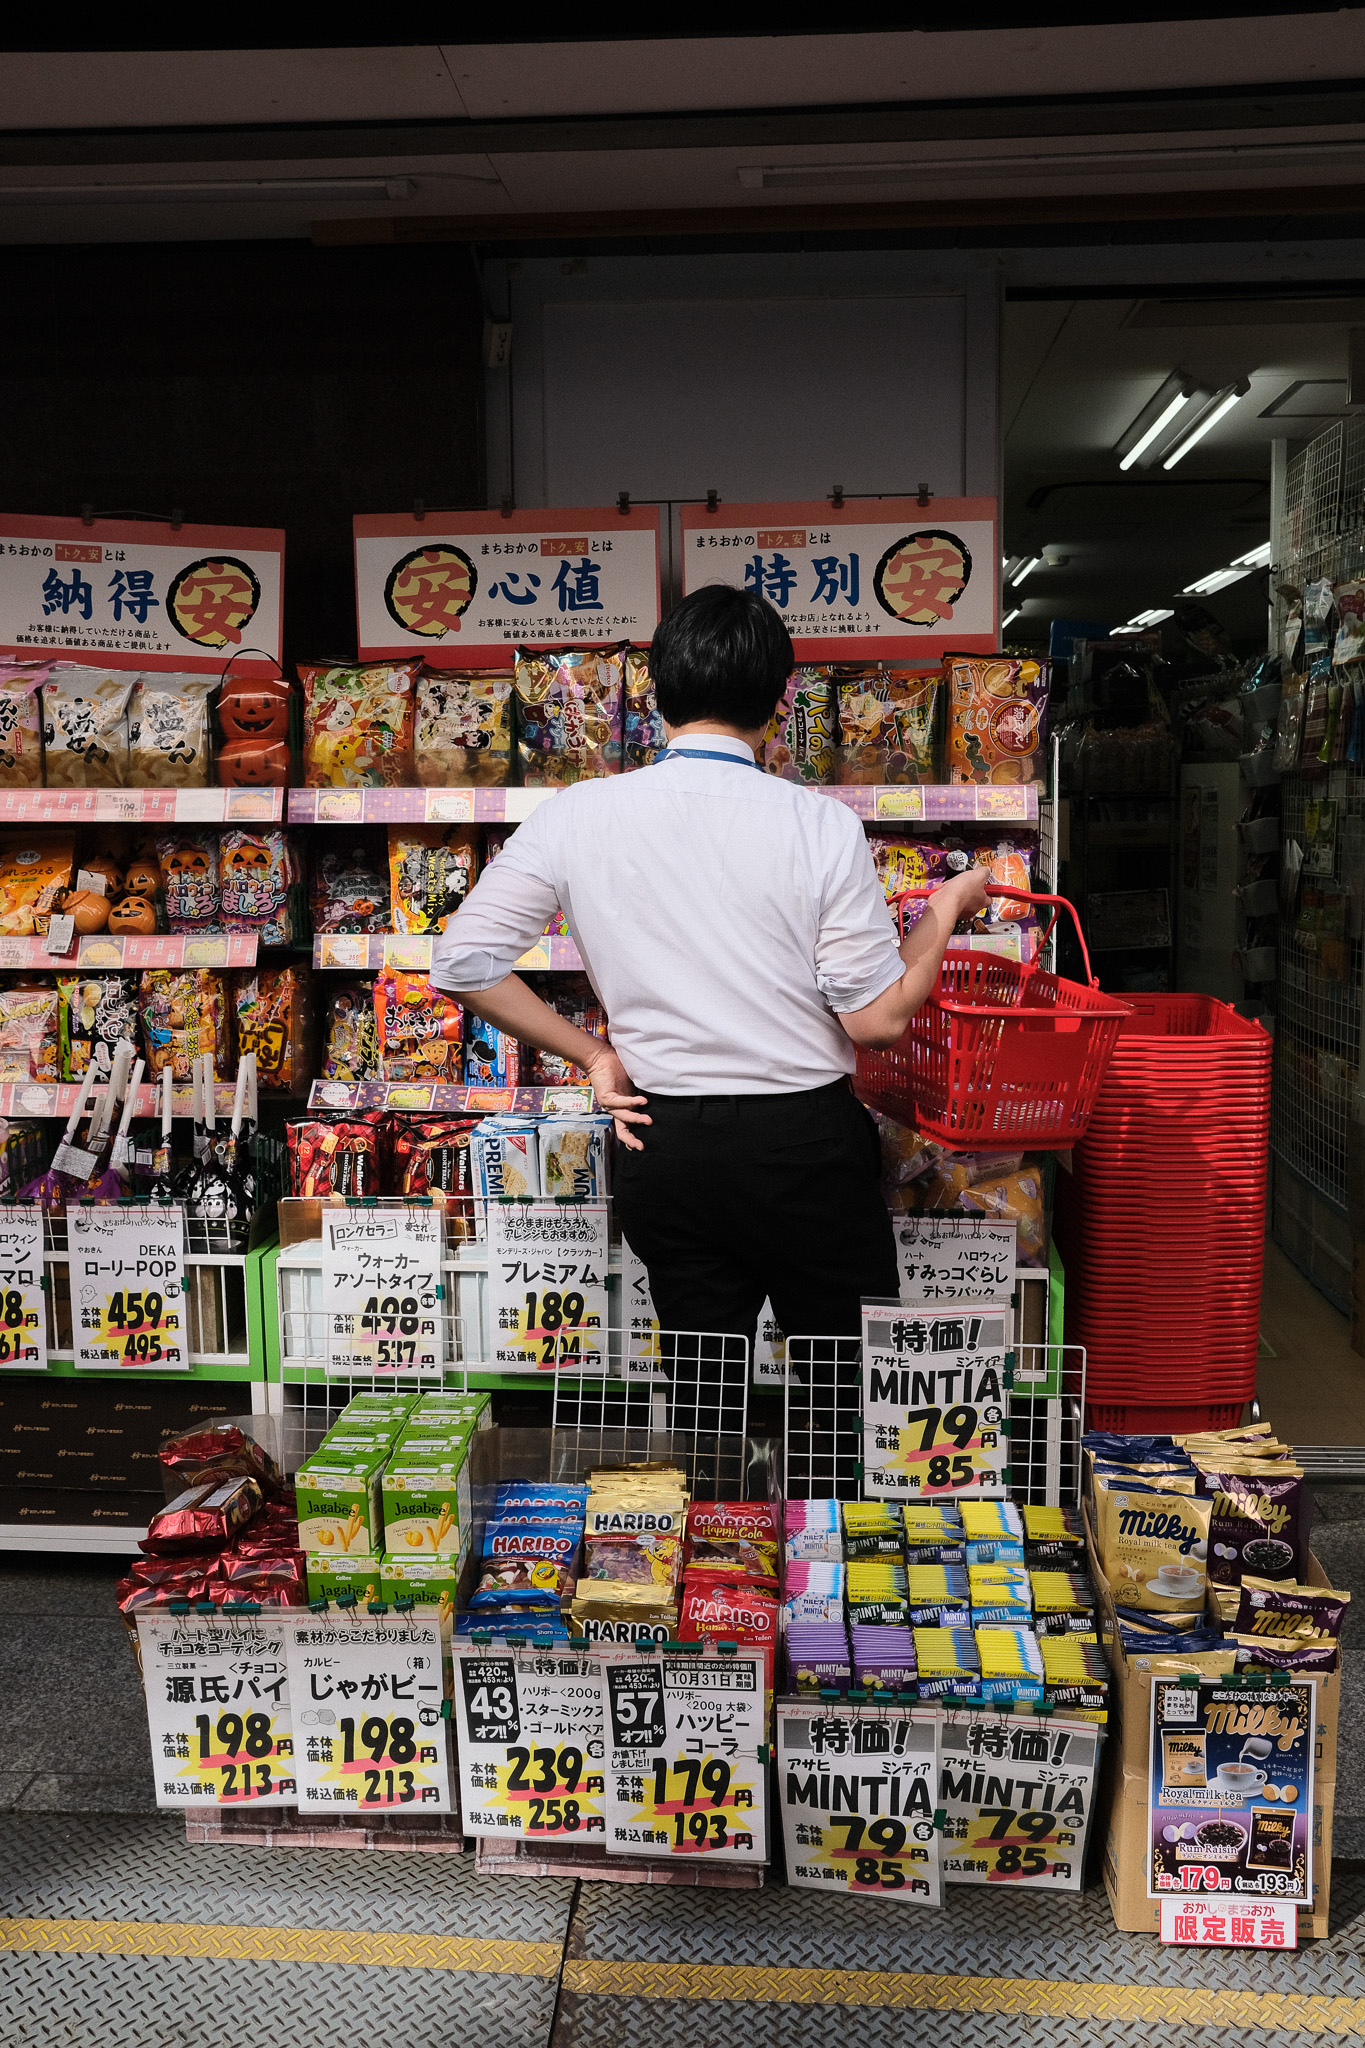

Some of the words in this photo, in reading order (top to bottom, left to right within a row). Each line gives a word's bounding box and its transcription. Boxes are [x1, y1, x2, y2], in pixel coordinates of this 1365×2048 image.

[481, 542, 538, 555] まちおかの
[591, 540, 614, 552] とは
[696, 535, 755, 548] まちおかの
[809, 532, 832, 544] とは
[104, 550, 126, 561] とは
[744, 552, 860, 608] 特別
[884, 536, 966, 620] 安
[394, 551, 472, 632] 安
[488, 558, 604, 612] 心値
[41, 568, 160, 624] 納得
[176, 562, 254, 644] 安
[478, 616, 638, 628] お客様に安心して楽しんでいただくために
[28, 623, 159, 639] お客様に納得していただける商品と
[502, 628, 613, 639] 価値ある商品をご提供します
[16, 634, 172, 652] 価格を追求し価値ある商品をご提供します
[426, 894, 438, 914] Mix
[458, 1150, 466, 1190] Walkers
[336, 1225, 394, 1240] ロングセラー
[416, 1234, 437, 1242] 続けて
[78, 1246, 102, 1254] やおきん
[139, 1244, 176, 1256] DEKA
[904, 1252, 924, 1260] ハート
[958, 1251, 1008, 1262] ハロウィン
[358, 1252, 420, 1269] ウォーカー
[85, 1260, 177, 1278] ローリーPOP
[502, 1261, 600, 1284] プレミアム
[904, 1264, 1008, 1284] すみっコぐらし
[334, 1272, 434, 1290] アソートタイプ
[80, 1349, 120, 1360] 税込価格
[496, 1350, 537, 1362] 税込価格
[871, 1356, 910, 1368] アサヒ
[956, 1356, 1000, 1368] ミンティア
[869, 1368, 1002, 1406] MINTIA
[872, 1474, 921, 1488] 税込価格
[307, 1500, 356, 1518] Jagabee
[394, 1502, 446, 1516] Jagabee
[1212, 1490, 1292, 1534] Milky
[594, 1512, 674, 1532] HARIBO
[1212, 1518, 1233, 1527] Rum
[1118, 1509, 1201, 1556] Milky
[492, 1536, 572, 1554] HARIBO
[878, 1541, 900, 1550] MINTIA
[1118, 1536, 1140, 1546] Royal
[1144, 1540, 1162, 1548] milk
[1164, 1542, 1177, 1550] tea
[940, 1550, 962, 1559] MINTIA
[998, 1548, 1020, 1556] MINTIA
[320, 1584, 371, 1598] Jagabee
[689, 1597, 770, 1632] HARIBO
[804, 1608, 823, 1616] MINTIA
[882, 1612, 904, 1620] MINTIA
[944, 1613, 966, 1621] MINTIA
[583, 1619, 670, 1642] HARIBO
[1068, 1618, 1092, 1628] MINTIA
[294, 1629, 436, 1644] 素材からこだわりました
[158, 1640, 282, 1656] チョコをコーティング
[168, 1662, 196, 1670] 三立製菓
[304, 1657, 340, 1668] カルビー
[310, 1672, 438, 1700] じゃがビー
[672, 1673, 731, 1687] 10月31日
[736, 1680, 752, 1688] 期限
[166, 1674, 288, 1704] 源氏パイ
[666, 1691, 702, 1700] ハリボー
[953, 1685, 977, 1694] MINTIA
[1016, 1688, 1040, 1696] MINTIA
[470, 1686, 514, 1720] 43
[1080, 1694, 1104, 1704] MINTIA
[616, 1692, 660, 1724] 57
[676, 1714, 750, 1734] ハッピー
[1204, 1702, 1305, 1752] Milky
[612, 1750, 646, 1759] お値下げ
[686, 1738, 739, 1756] コーラ
[786, 1758, 830, 1772] アサヒ
[882, 1762, 932, 1776] ミンティア
[944, 1757, 986, 1772] アサヒ
[1037, 1770, 1088, 1787] ミンティア
[164, 1782, 216, 1796] 税込価格
[306, 1788, 358, 1801] 税込価格
[786, 1772, 932, 1818] MINTIA
[942, 1769, 1085, 1816] MINTIA
[1162, 1788, 1193, 1799] Royal
[1194, 1789, 1222, 1800] milk
[1224, 1792, 1243, 1800] tea
[469, 1812, 522, 1828] 税込価格
[614, 1828, 668, 1844] 税込価格
[1179, 1844, 1203, 1854] Rum
[1205, 1844, 1238, 1854] Raisin
[795, 1865, 848, 1882] 税込価格
[1174, 1916, 1285, 1945] 限定販売
